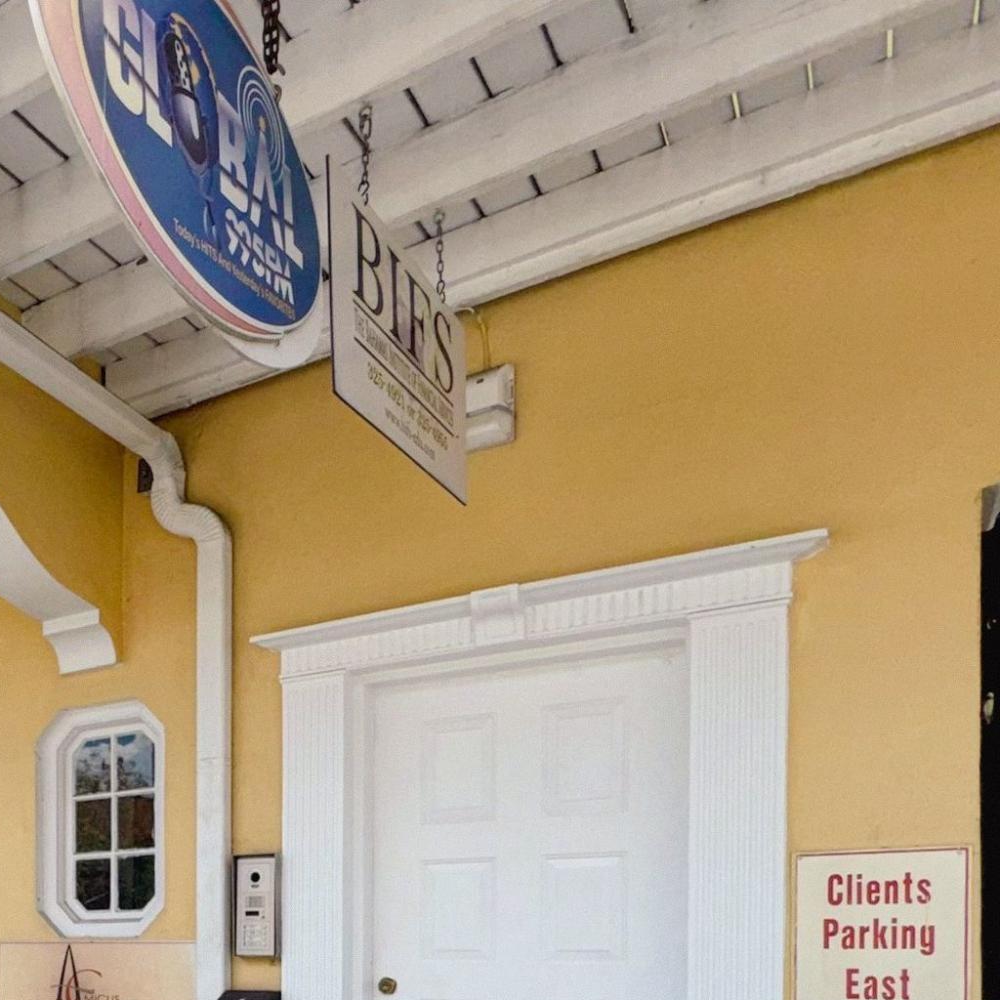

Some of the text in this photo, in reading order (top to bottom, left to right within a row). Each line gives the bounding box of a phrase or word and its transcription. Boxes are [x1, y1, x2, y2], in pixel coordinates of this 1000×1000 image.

[351, 202, 453, 394] BIFS
[827, 871, 932, 906] Clients
[823, 918, 936, 956] Parking
[846, 968, 910, 1000] East
